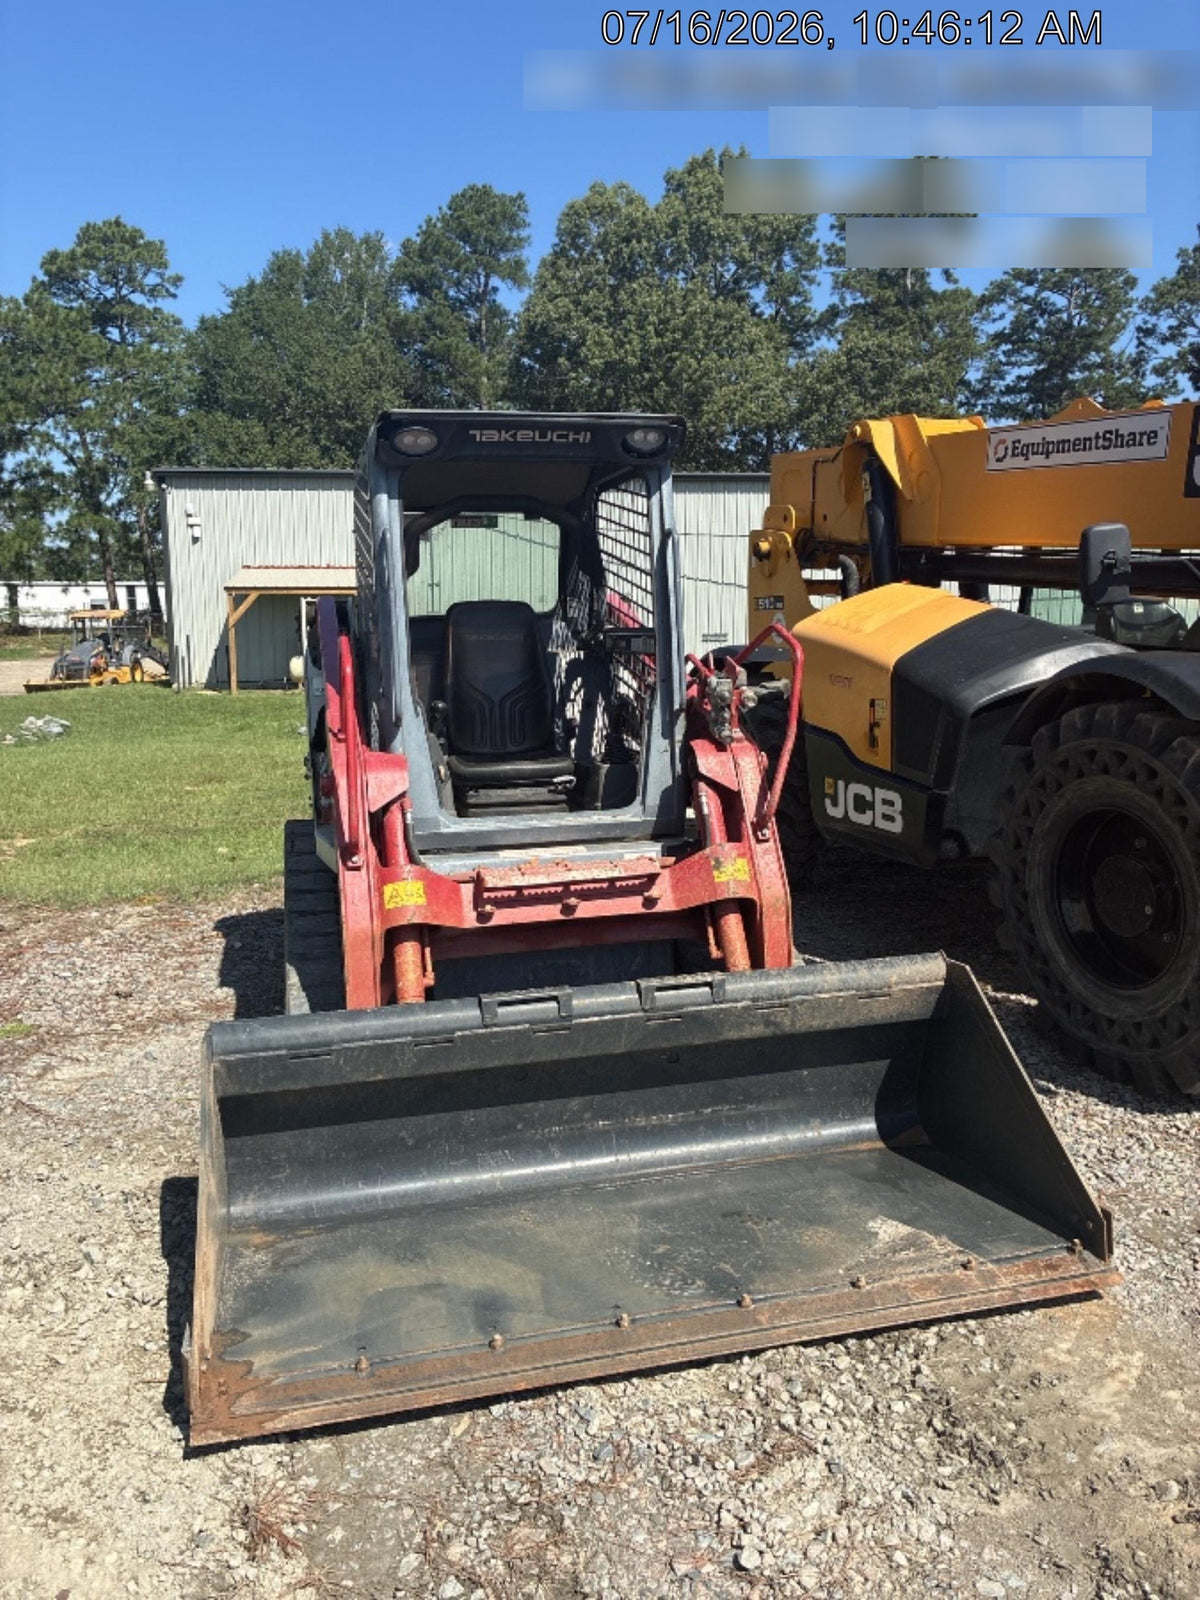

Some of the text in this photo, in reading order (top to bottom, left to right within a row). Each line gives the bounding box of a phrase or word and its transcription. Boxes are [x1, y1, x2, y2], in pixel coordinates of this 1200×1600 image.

[468, 429, 592, 443] TAKEUCHI
[1010, 429, 1159, 461] EquipmentShare
[824, 779, 904, 833] JCB
